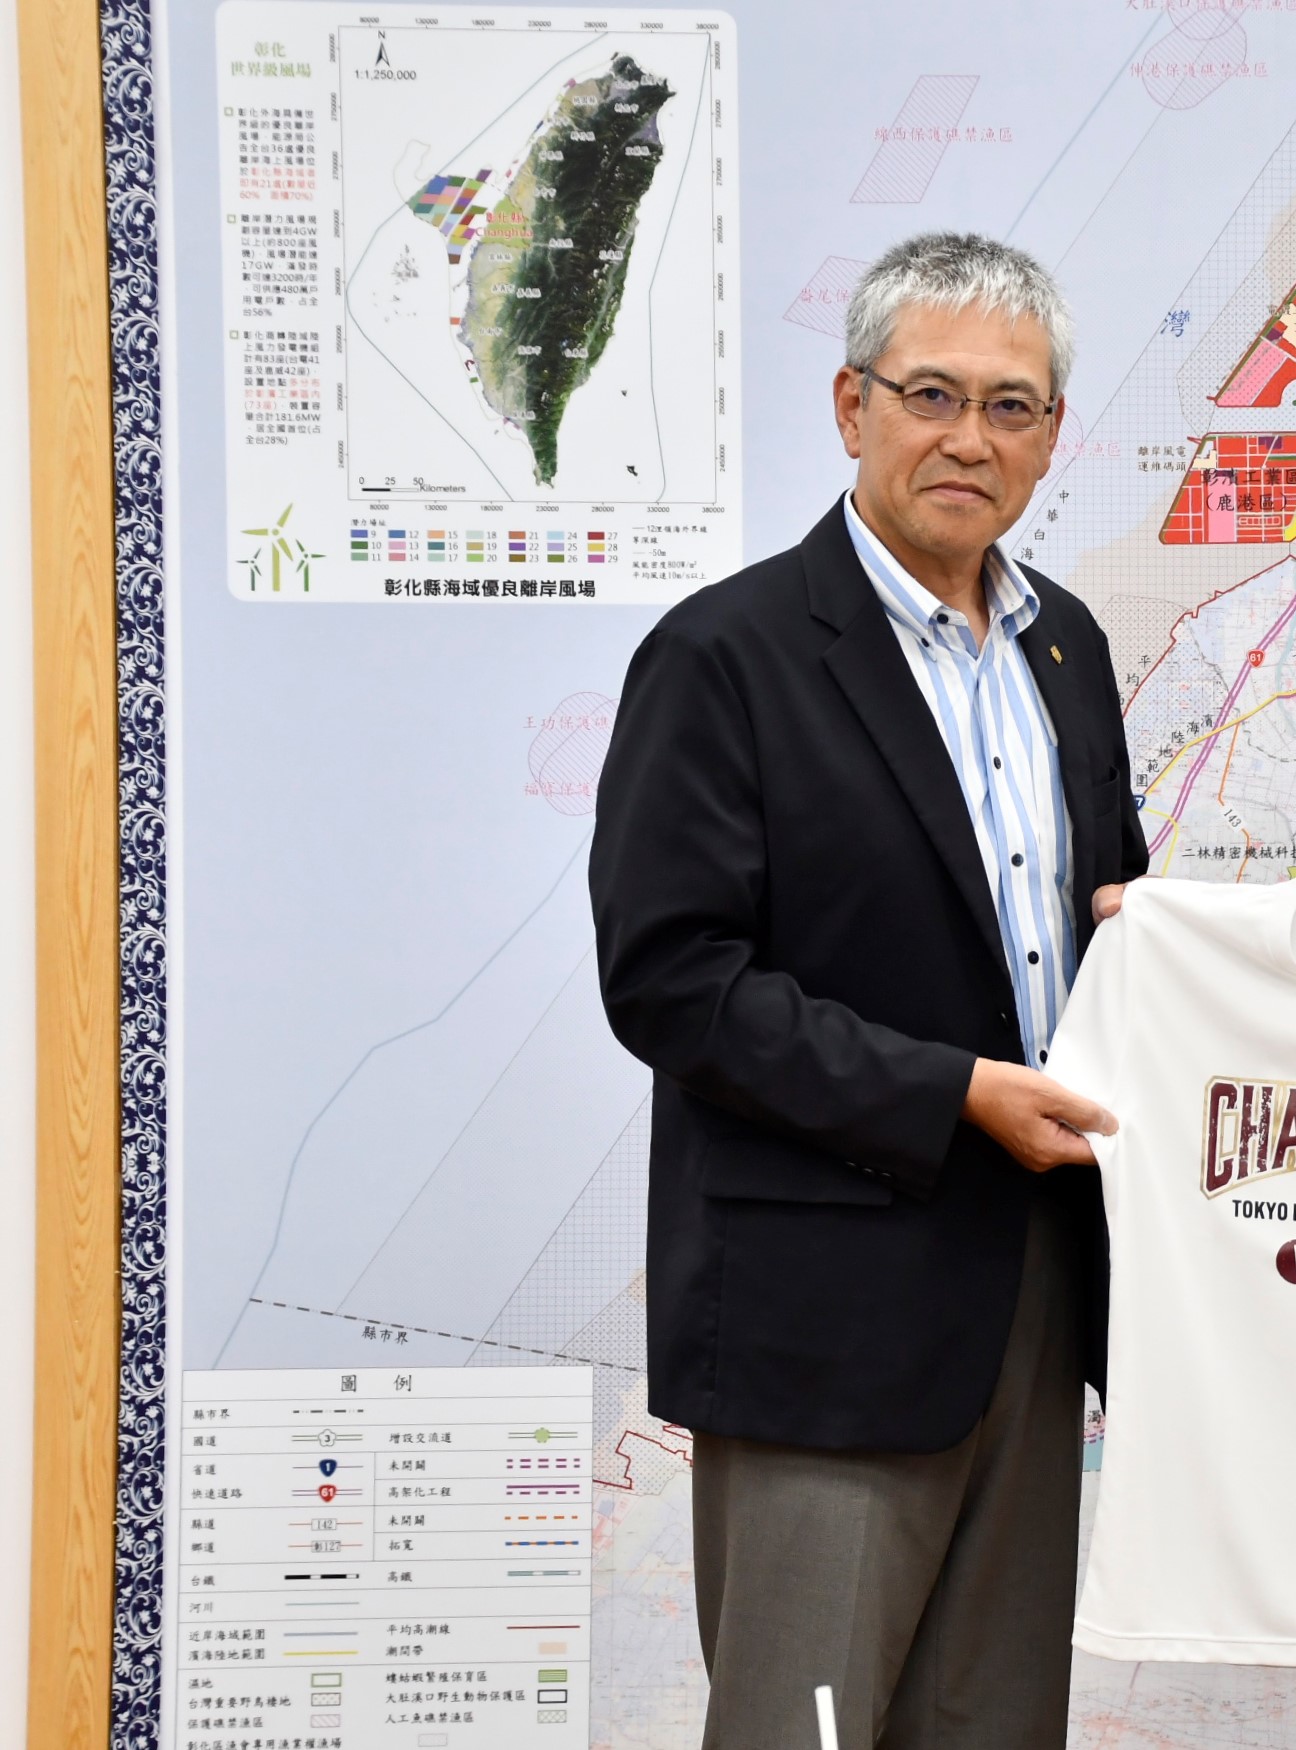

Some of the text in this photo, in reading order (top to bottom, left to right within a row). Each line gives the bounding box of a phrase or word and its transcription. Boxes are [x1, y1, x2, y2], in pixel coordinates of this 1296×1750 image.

[378, 31, 385, 39] N
[354, 70, 417, 81] 1:1,250,000
[475, 227, 533, 239] Changhua
[1161, 309, 1191, 338] 灣
[1137, 445, 1187, 459] 離岸風電
[1137, 460, 1187, 472] 運維碼頭
[385, 476, 396, 485] 25
[413, 477, 424, 485] 50
[420, 483, 466, 493] Kilometers
[409, 530, 419, 538] 12
[448, 531, 459, 539] 15
[567, 532, 578, 540] 24
[608, 532, 618, 540] 27
[409, 542, 419, 550] 13
[448, 542, 459, 550] 16
[529, 543, 539, 551] 22
[567, 543, 578, 551] 25
[608, 543, 618, 551] 28
[371, 553, 382, 561] 11
[448, 554, 459, 562] 17
[487, 554, 497, 563] 20
[529, 555, 539, 563] 23
[567, 555, 578, 563] 26
[608, 555, 618, 563] 29
[384, 578, 597, 598] 彰化縣海域優良離岸風場
[1223, 808, 1242, 829] 143
[1232, 1199, 1289, 1222] TOKYO
[361, 1324, 410, 1345] 縣市界
[192, 1408, 231, 1420] 縣市界
[193, 1435, 217, 1448] 國道
[389, 1431, 452, 1445] 增設交流道
[193, 1463, 217, 1476] 省道
[388, 1459, 426, 1472] 未開闢
[191, 1487, 243, 1500] 快速道路
[388, 1485, 452, 1499] 高架化工程
[191, 1518, 216, 1531] 縣道
[316, 1518, 334, 1531] 142
[388, 1514, 426, 1527] 未開闢
[191, 1541, 216, 1554] 鄉道
[388, 1539, 415, 1552] 拓寬
[191, 1574, 216, 1587] 台鐵
[387, 1570, 413, 1584] 高鐵
[189, 1602, 214, 1615] 河川
[189, 1628, 266, 1642] 近岸海域範圍
[386, 1623, 451, 1637] 平均高潮線
[188, 1648, 265, 1662] 濱海陸地範圍
[385, 1644, 424, 1658] 潮間帶
[188, 1677, 214, 1691] 濕地
[187, 1695, 292, 1710] 台灣重要野鳥棲地
[385, 1690, 526, 1705] 大肚溪口野生動物保護區
[187, 1716, 264, 1730] 保護礁禁漁區
[385, 1711, 475, 1725] 人工魚礁禁漁區
